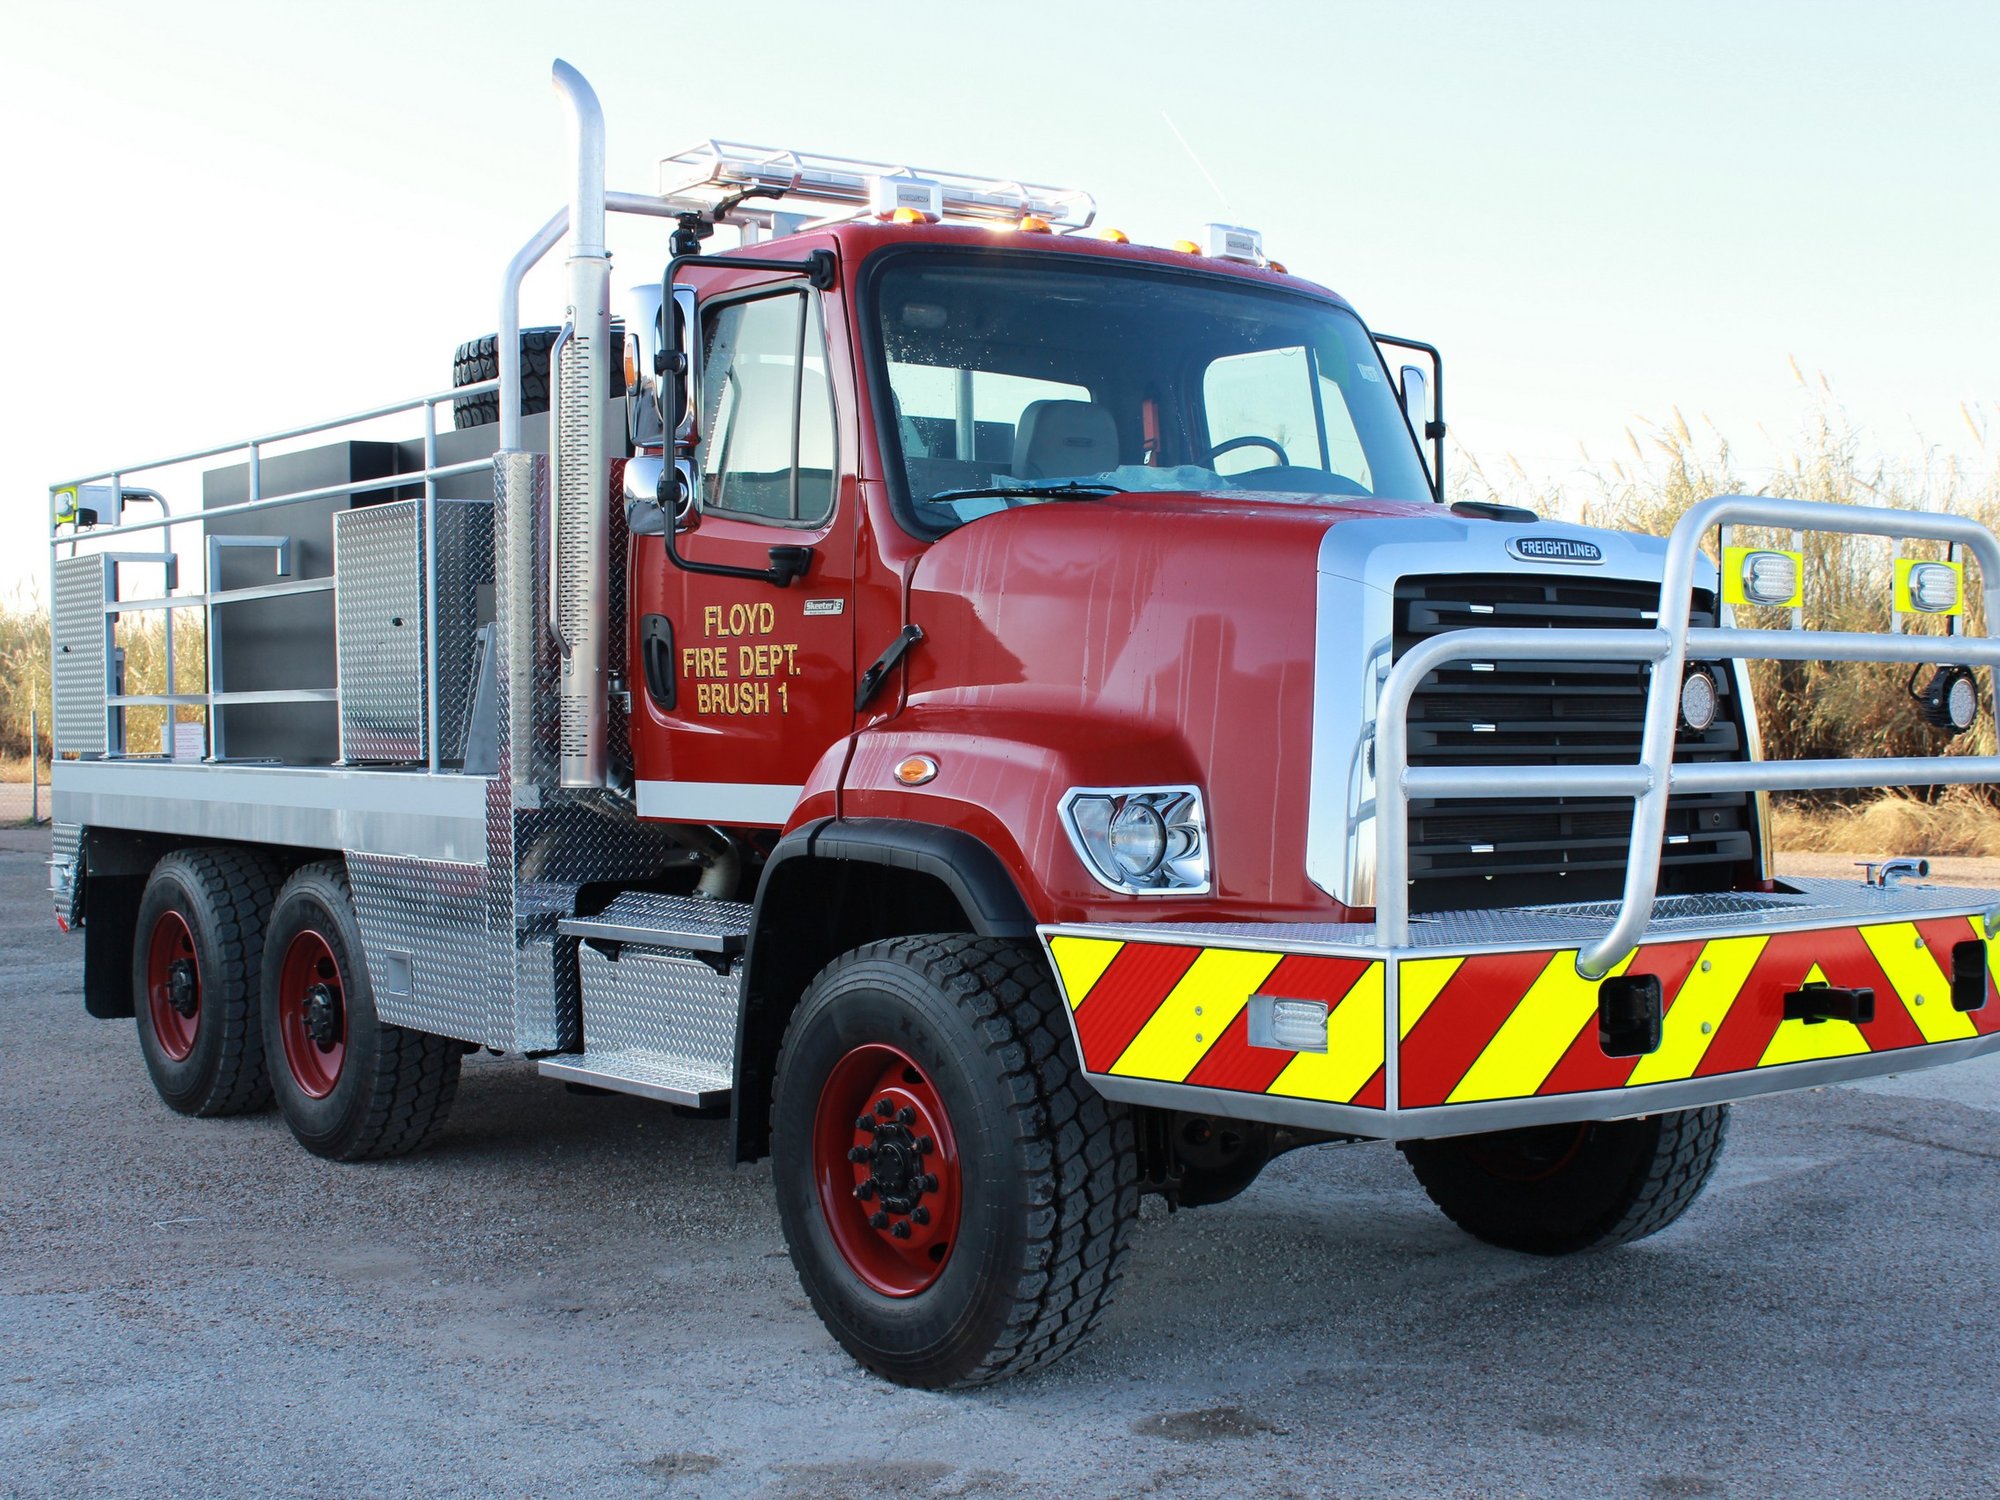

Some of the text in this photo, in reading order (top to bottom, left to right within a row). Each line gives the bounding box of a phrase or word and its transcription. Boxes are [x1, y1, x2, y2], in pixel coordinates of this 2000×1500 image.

[1521, 541, 1598, 557] FREIGHTLINER
[704, 603, 775, 637] FLOYD
[682, 643, 800, 678] FIRE DEPT.
[697, 681, 789, 714] BRUSH 1
